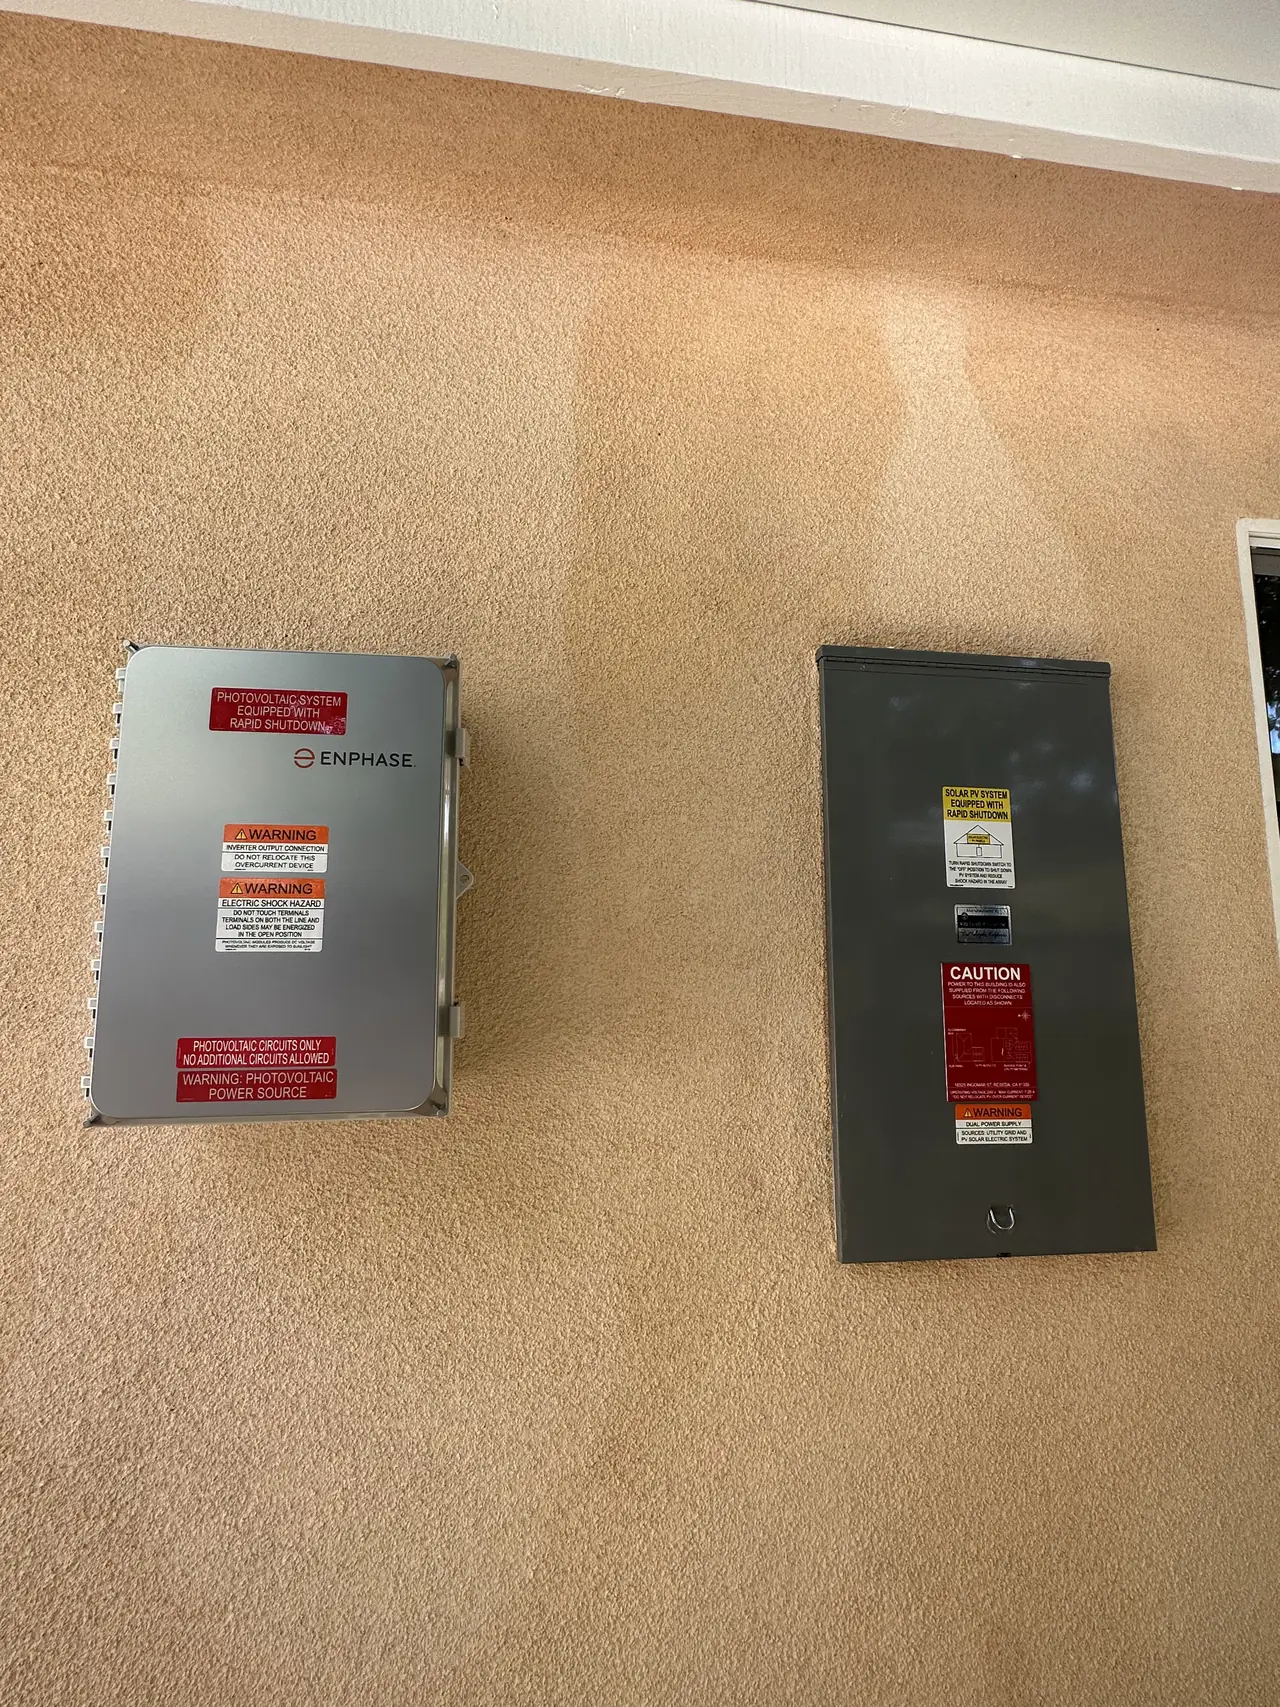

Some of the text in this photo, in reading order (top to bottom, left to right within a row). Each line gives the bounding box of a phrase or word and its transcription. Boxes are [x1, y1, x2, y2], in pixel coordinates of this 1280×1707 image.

[217, 692, 341, 706] PHOTOVOLTAIC SYSTEM
[237, 706, 320, 718] EQUIPPED WITH
[230, 718, 325, 731] RAPID SHUTDOWN
[320, 752, 413, 768] ENPHASE
[946, 789, 969, 797] SOLAR
[981, 790, 1007, 799] SYSTEM
[951, 799, 1004, 809] EQUIPPED WITH
[947, 810, 1008, 819] RAPID SHUTDOWN
[249, 829, 317, 840] WARNING
[245, 883, 313, 894] WARNING
[950, 966, 1020, 980] CAUTION
[194, 1040, 322, 1052] PHOTOVOLTAIC CIRCUITS ONLY
[184, 1052, 329, 1066] NO ADDITIONAL CIRCUITS ALLOWED
[183, 1071, 334, 1086] WARNING: PHOTOVOLTAIC
[209, 1086, 307, 1100] POWER SOURCE
[973, 1108, 1022, 1117] WARNING
